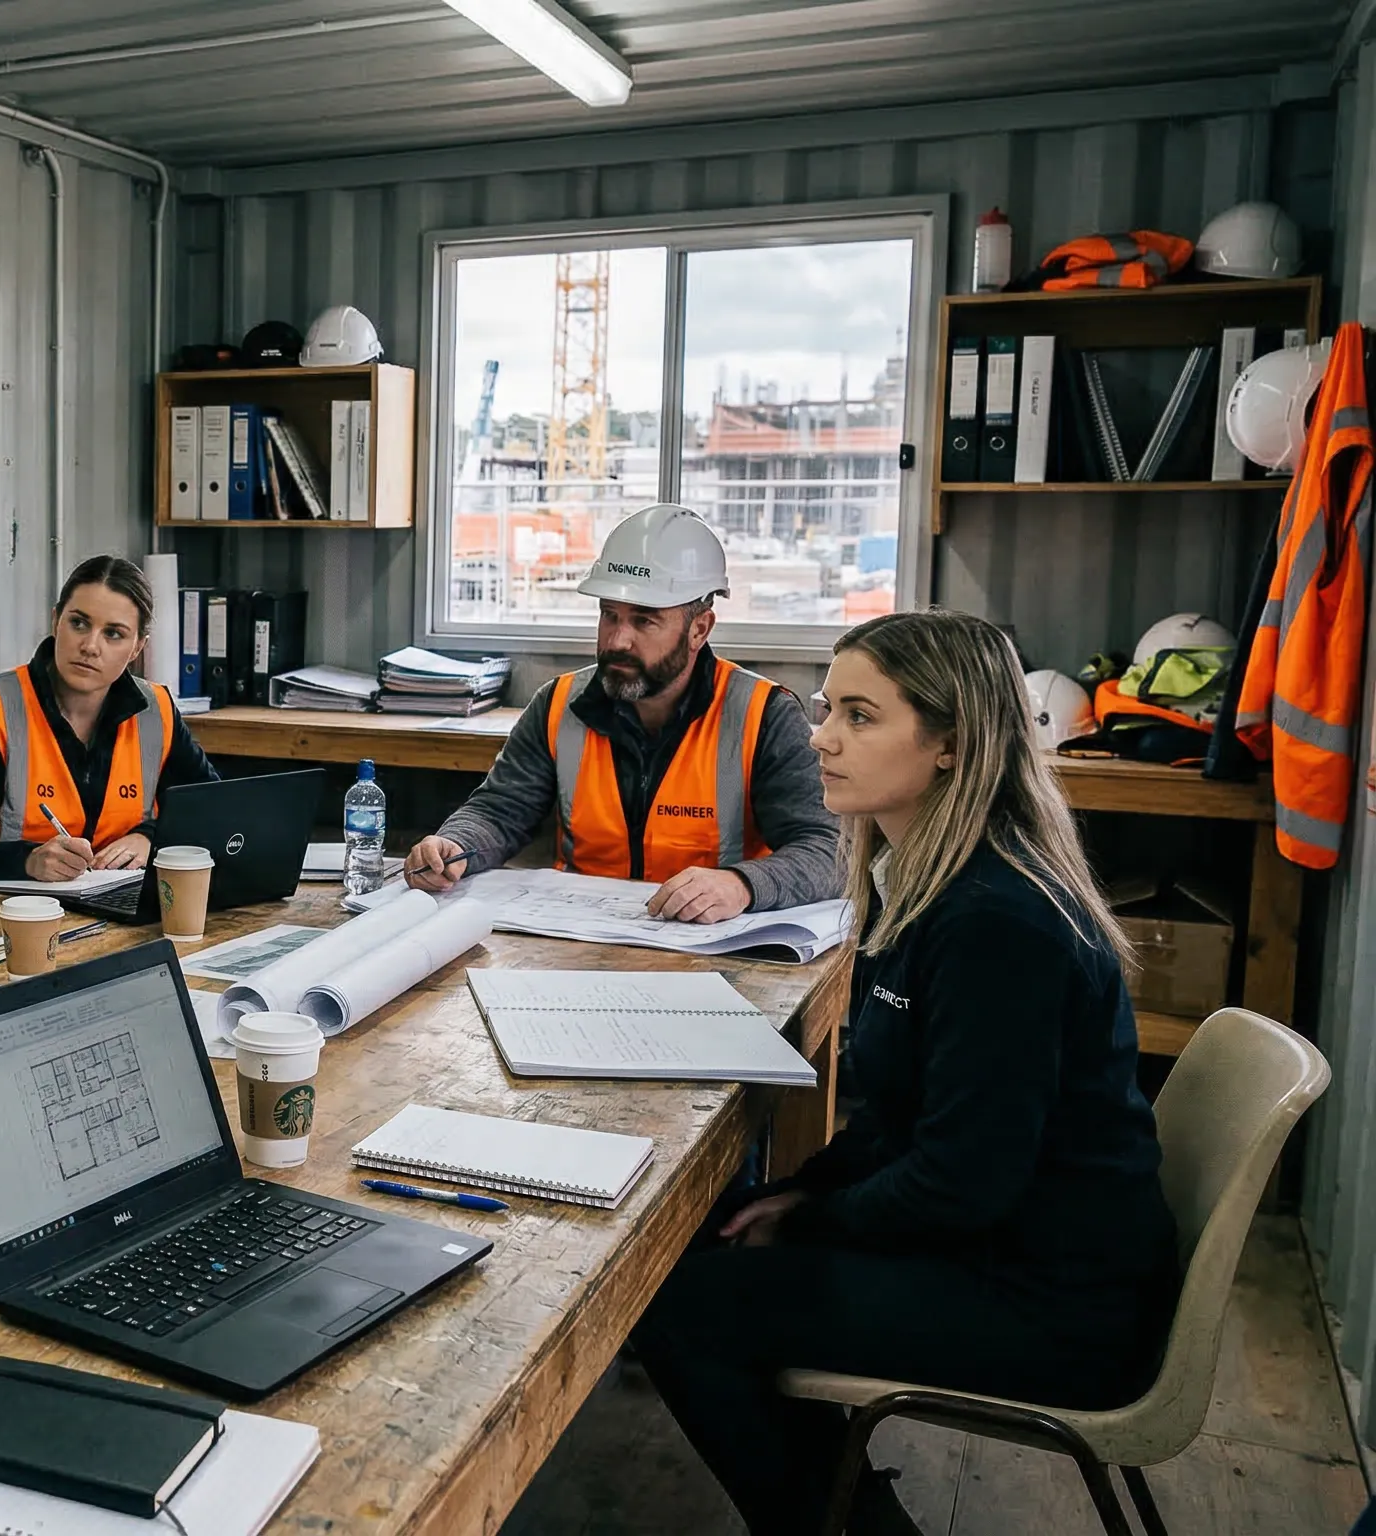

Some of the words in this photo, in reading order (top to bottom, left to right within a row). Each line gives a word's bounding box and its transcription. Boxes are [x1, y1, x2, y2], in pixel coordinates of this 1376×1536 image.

[37, 784, 55, 798] QS
[119, 784, 137, 798] QS
[657, 804, 714, 818] ENGINEER
